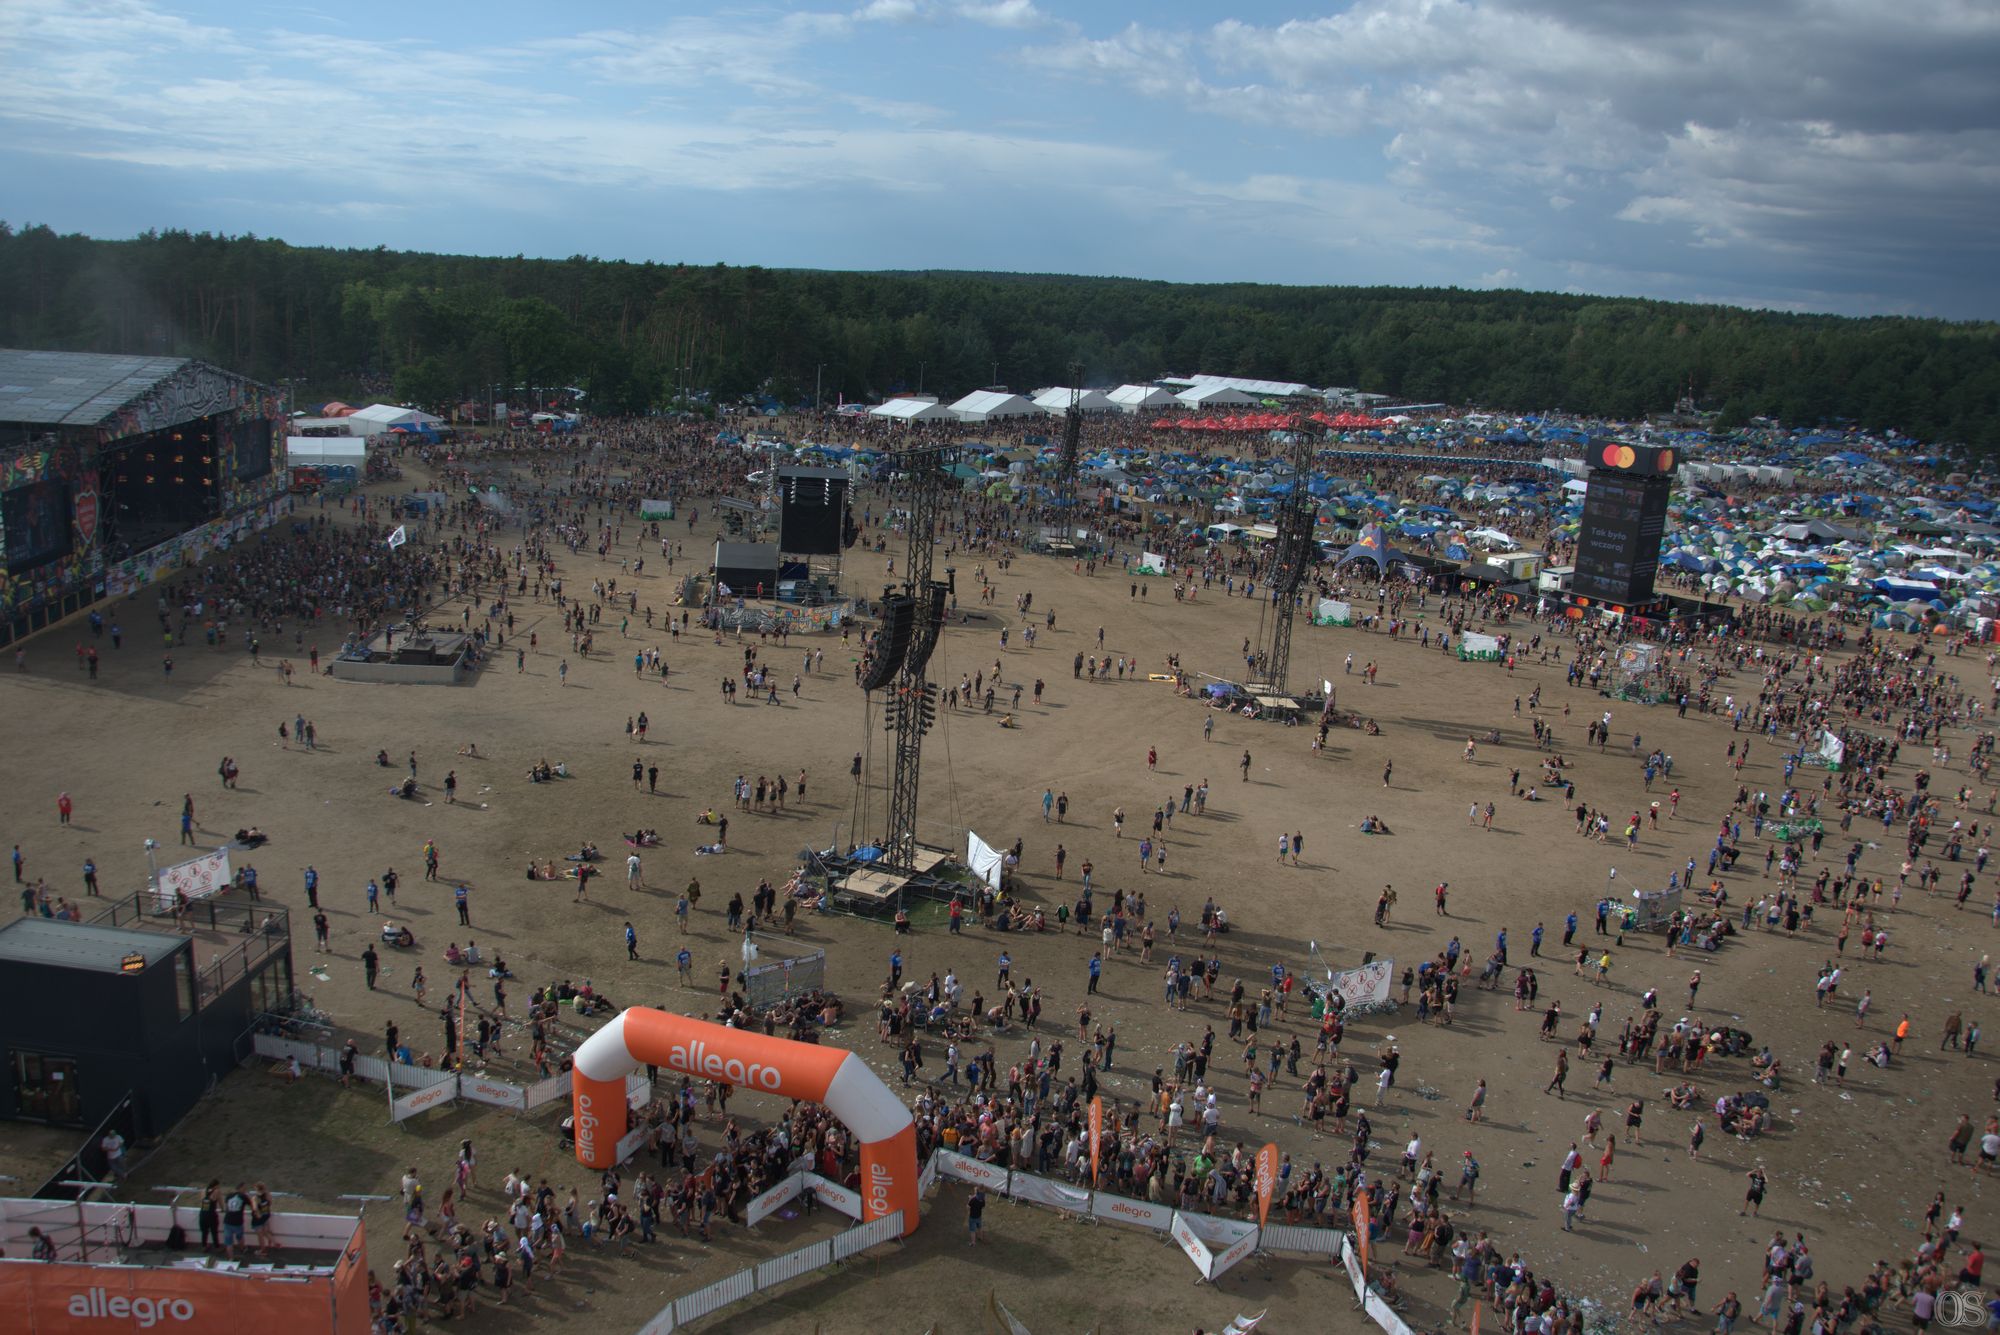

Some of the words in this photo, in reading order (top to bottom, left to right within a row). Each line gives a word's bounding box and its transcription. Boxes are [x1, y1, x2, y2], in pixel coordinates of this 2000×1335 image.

[1591, 527, 1608, 537] Tak
[1609, 530, 1627, 541] było
[1591, 539, 1624, 552] wczoraj
[669, 1040, 782, 1089] allegro
[411, 1089, 441, 1107] allegro
[476, 1084, 508, 1098] allegro
[578, 1094, 599, 1162] allegro
[955, 1161, 990, 1178] allegro
[1257, 1150, 1273, 1198] allegro
[761, 1187, 789, 1209] allegro
[815, 1183, 846, 1203] allegro
[868, 1163, 894, 1215] alleg
[1111, 1202, 1151, 1218] allegro
[68, 1287, 194, 1328] allegro
